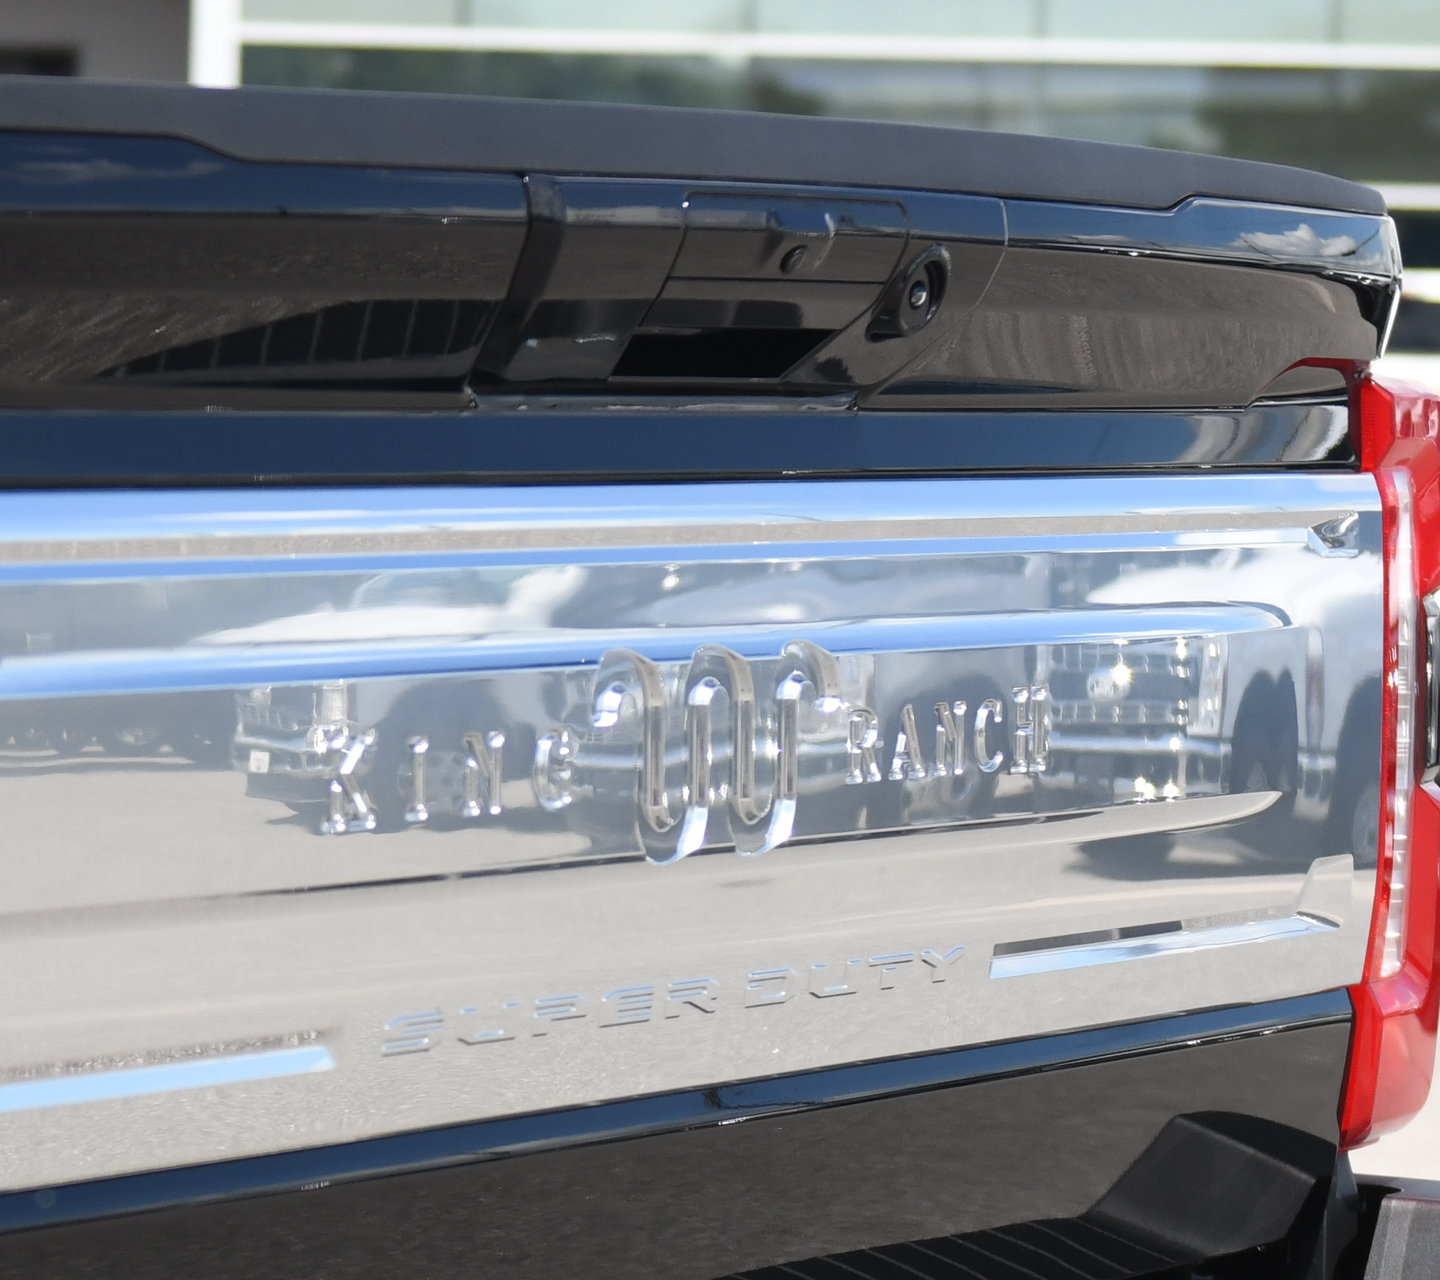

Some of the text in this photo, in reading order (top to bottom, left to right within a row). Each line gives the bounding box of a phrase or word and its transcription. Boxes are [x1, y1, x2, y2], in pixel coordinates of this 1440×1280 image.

[307, 682, 1051, 832] KING RANCH
[381, 945, 965, 1057] SUPER DUTY
